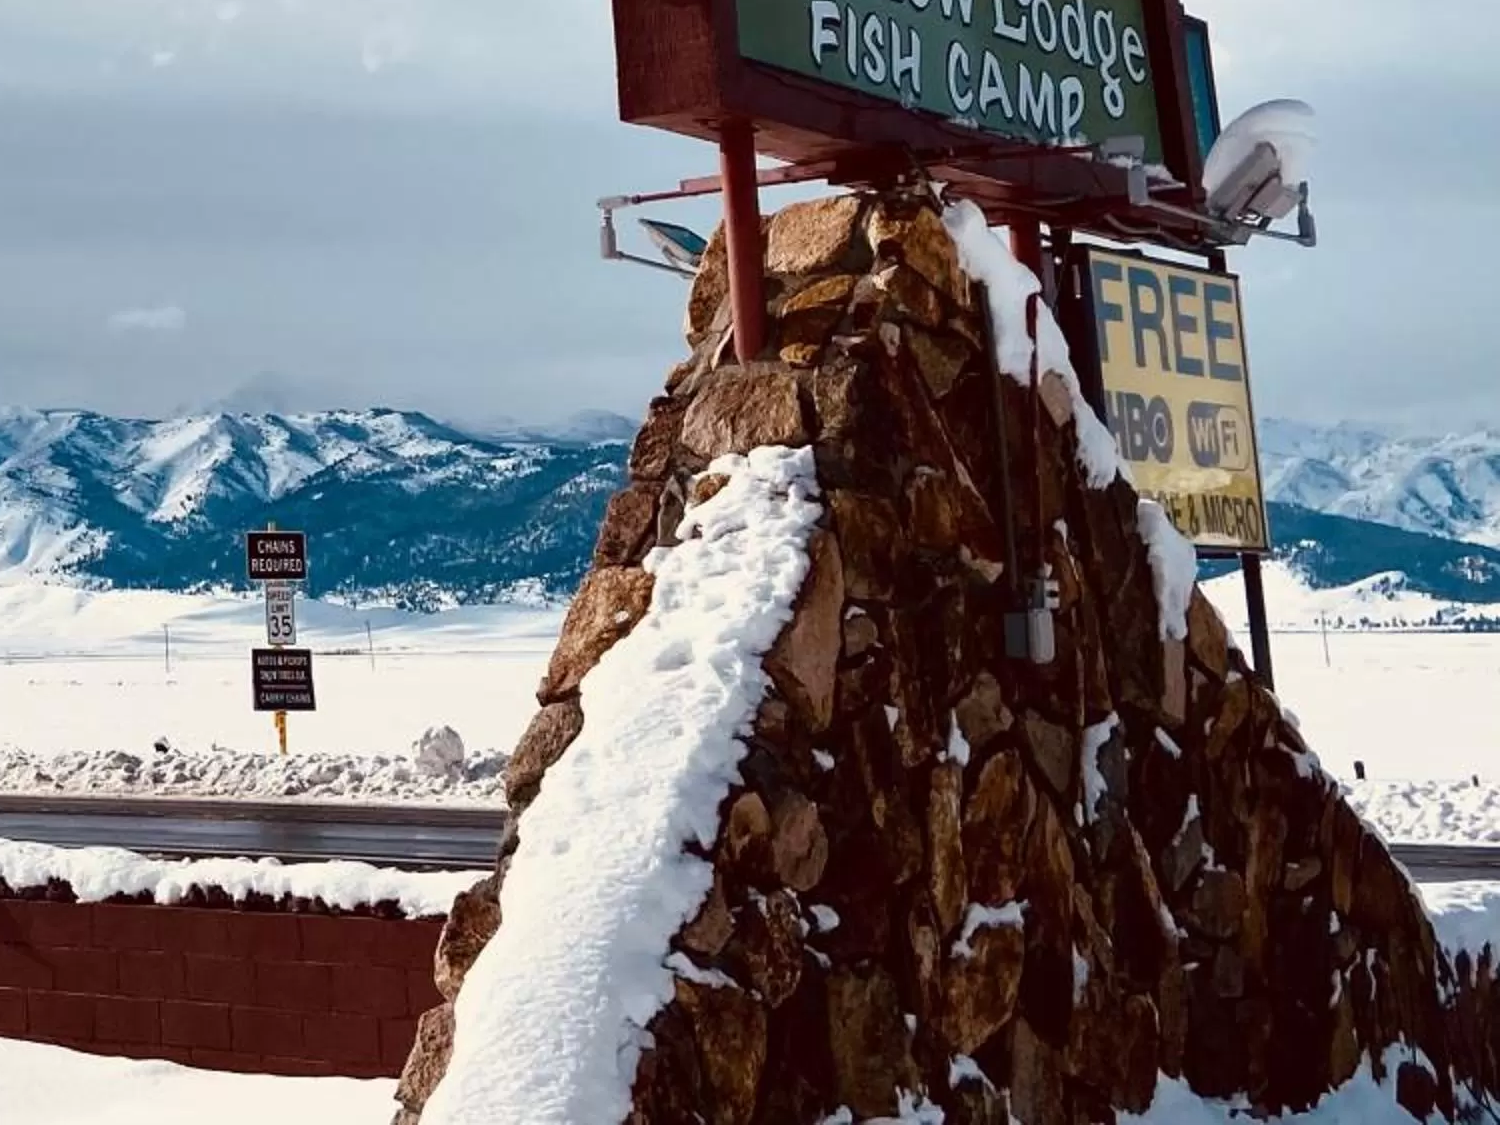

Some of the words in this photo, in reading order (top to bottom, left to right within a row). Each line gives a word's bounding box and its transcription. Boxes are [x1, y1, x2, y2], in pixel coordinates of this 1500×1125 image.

[810, 0, 922, 94] FISH
[947, 42, 1085, 139] CAMP
[1091, 260, 1242, 382] FREE
[1105, 390, 1174, 463] HBO
[1202, 494, 1259, 542] MICRO
[251, 558, 303, 572] REQUIRED
[257, 539, 296, 554] CHAINS
[271, 615, 293, 637] 35
